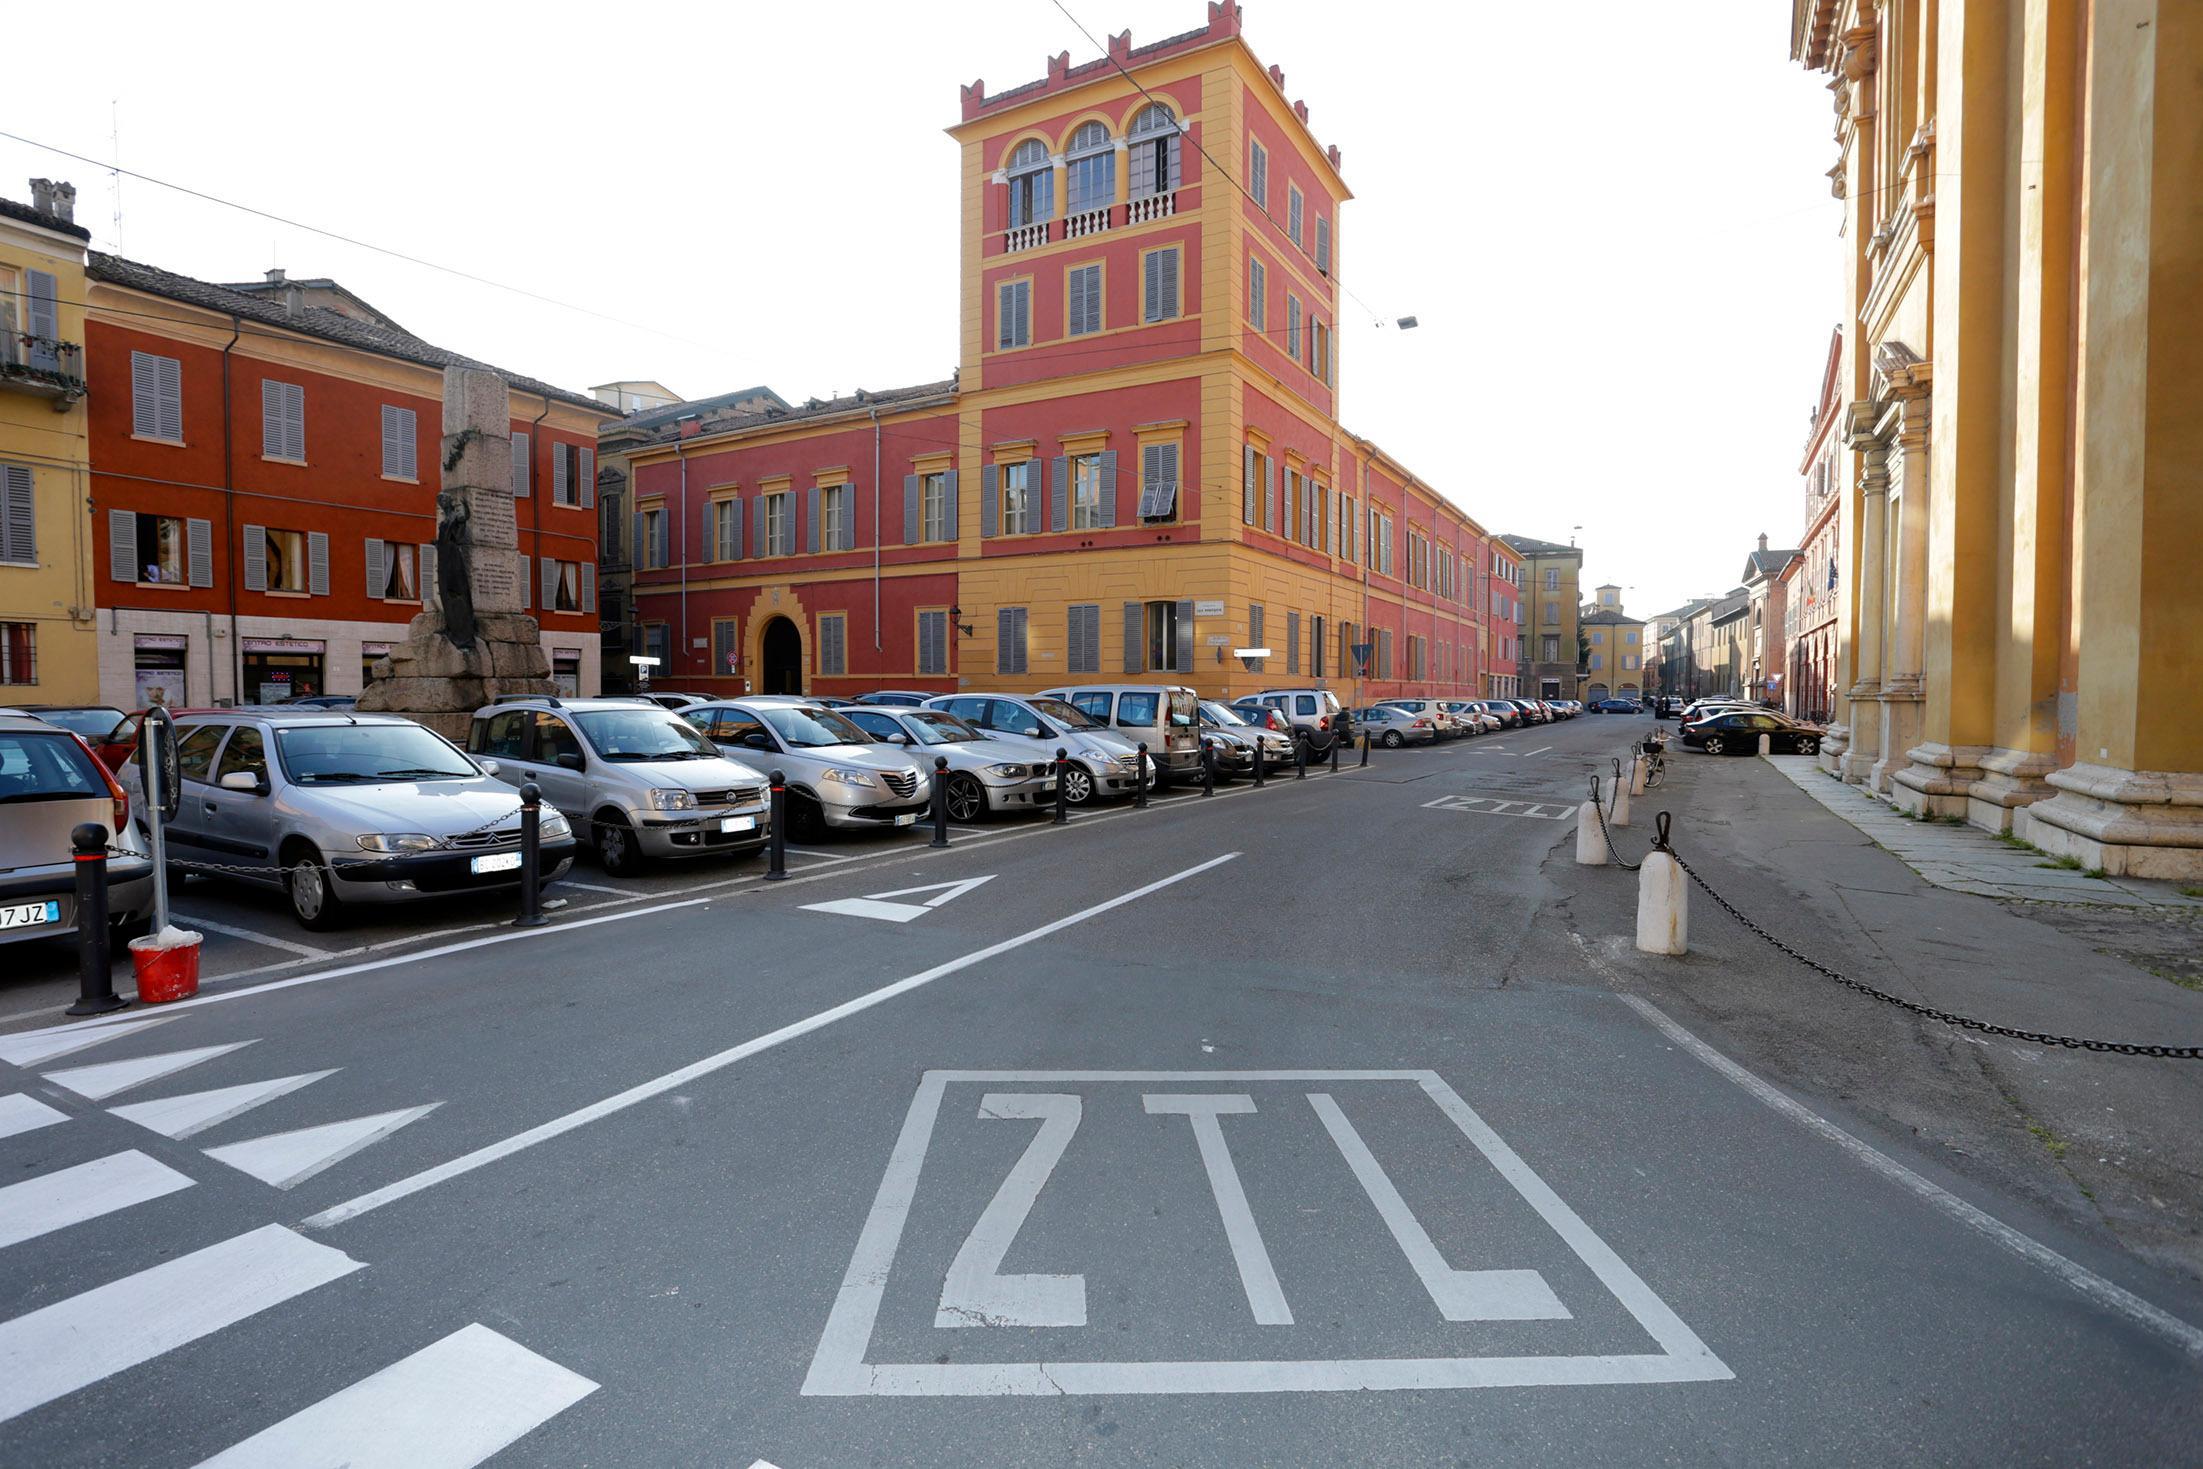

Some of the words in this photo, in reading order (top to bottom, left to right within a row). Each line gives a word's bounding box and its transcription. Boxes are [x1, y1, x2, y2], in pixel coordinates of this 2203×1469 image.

[275, 640, 309, 648] ESTETICO
[1441, 797, 1548, 817] ZTL
[935, 1093, 1574, 1327] ZTL
